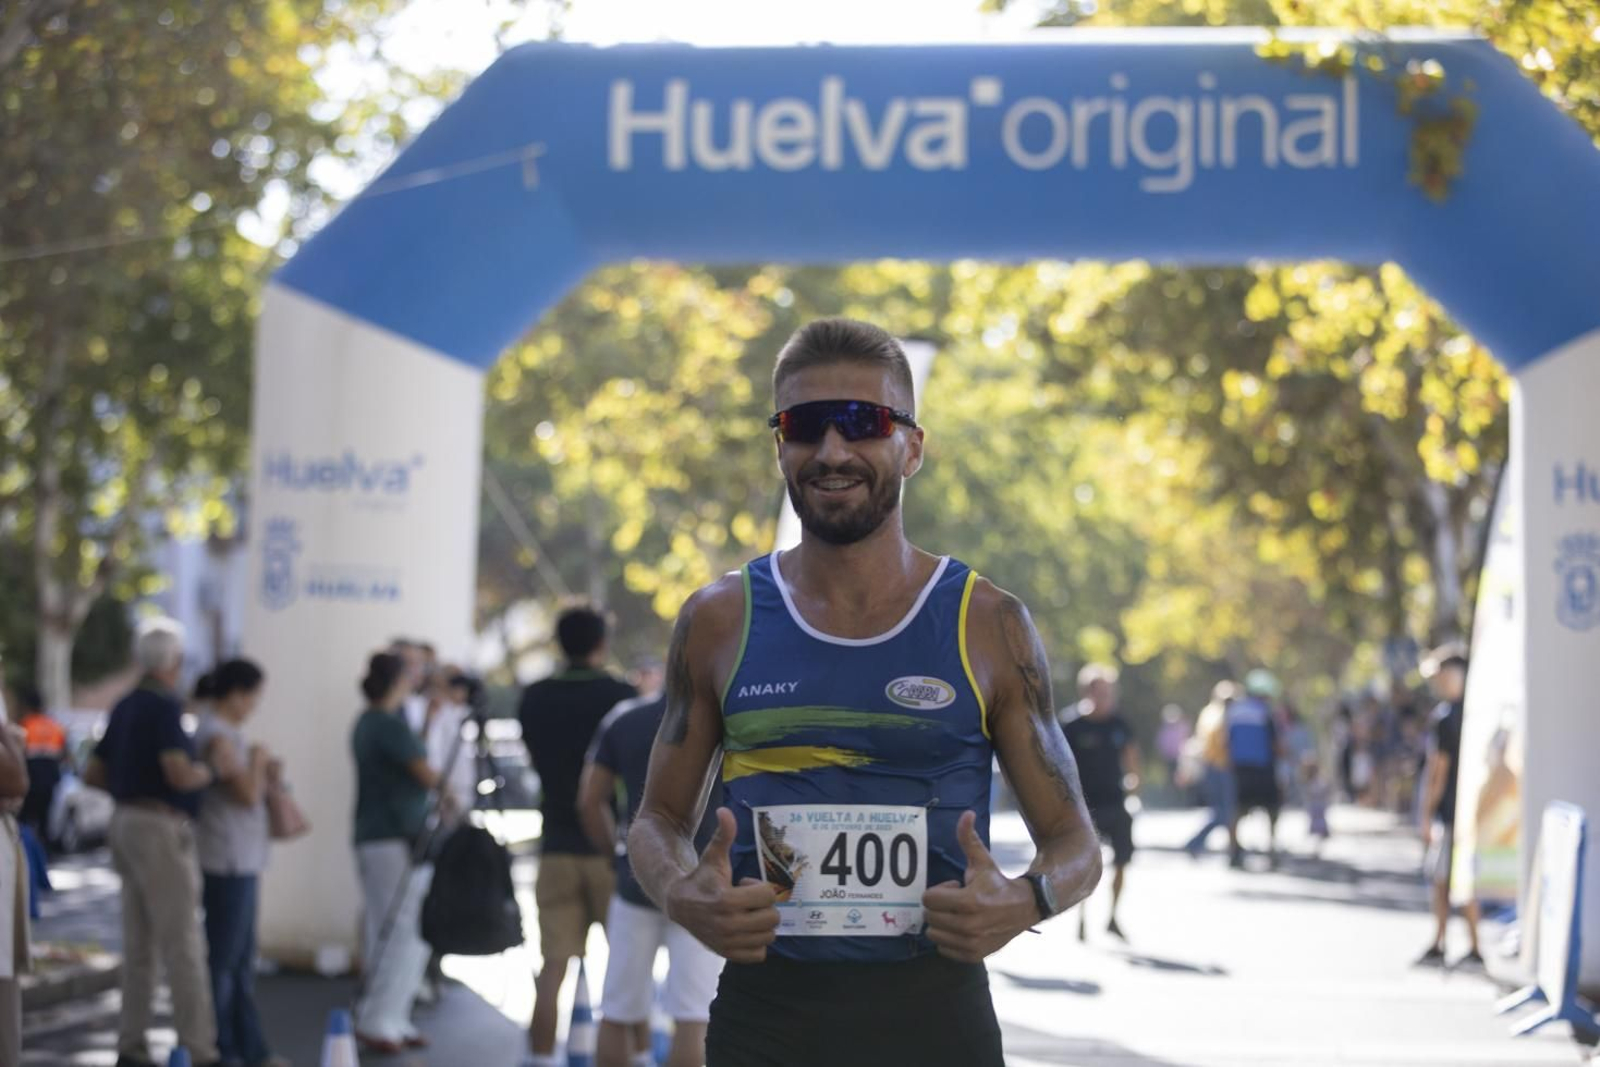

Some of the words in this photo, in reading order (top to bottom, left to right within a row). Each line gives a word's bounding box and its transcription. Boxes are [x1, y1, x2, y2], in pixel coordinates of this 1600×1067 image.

[608, 74, 969, 172] Huelva
[1002, 72, 1361, 193] original
[264, 452, 410, 492] Huelva
[738, 681, 799, 698] ANAKY
[806, 811, 852, 823] VUELTA
[856, 812, 864, 823] A
[869, 812, 915, 824] HUELVA
[820, 832, 918, 887] 400
[819, 888, 846, 899] JOÃO
